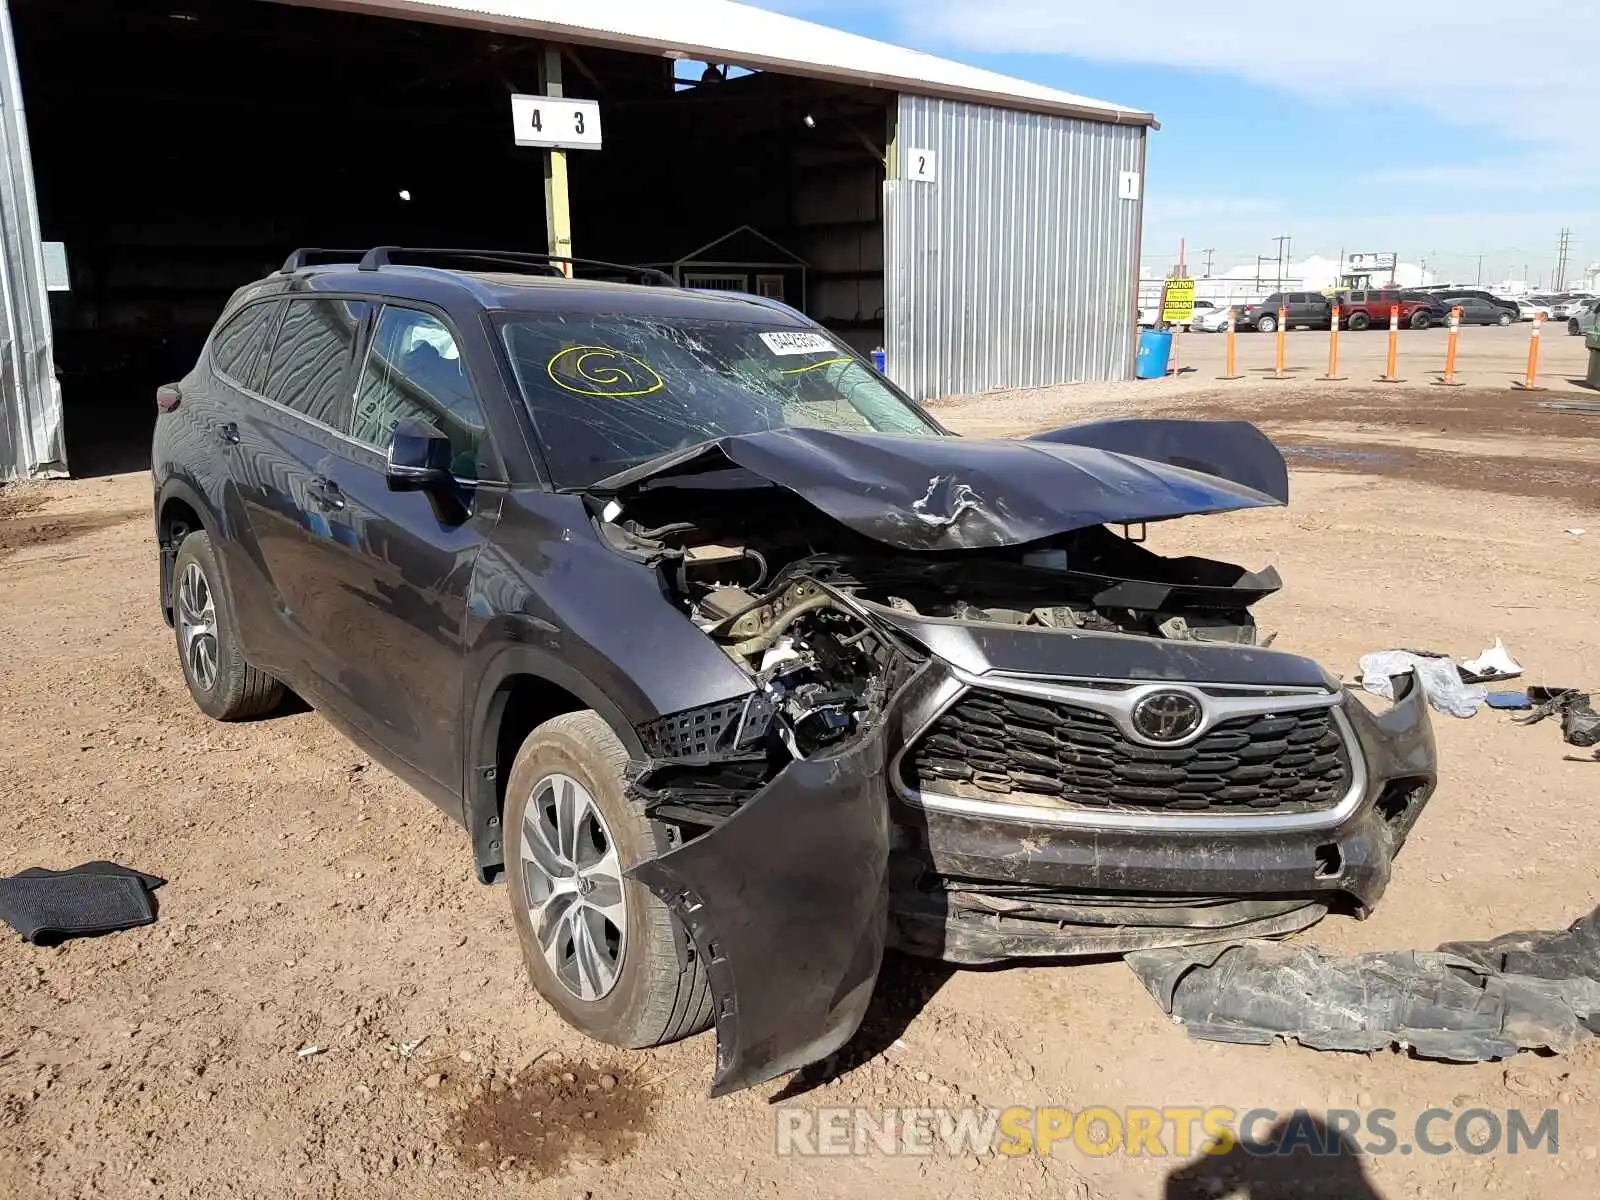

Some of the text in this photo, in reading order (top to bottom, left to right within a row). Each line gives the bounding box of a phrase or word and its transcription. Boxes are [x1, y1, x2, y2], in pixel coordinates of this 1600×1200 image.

[532, 109, 585, 134] 4 3
[919, 155, 925, 174] 2
[1165, 280, 1194, 289] CAUTION
[1164, 301, 1192, 309] CUIDADO
